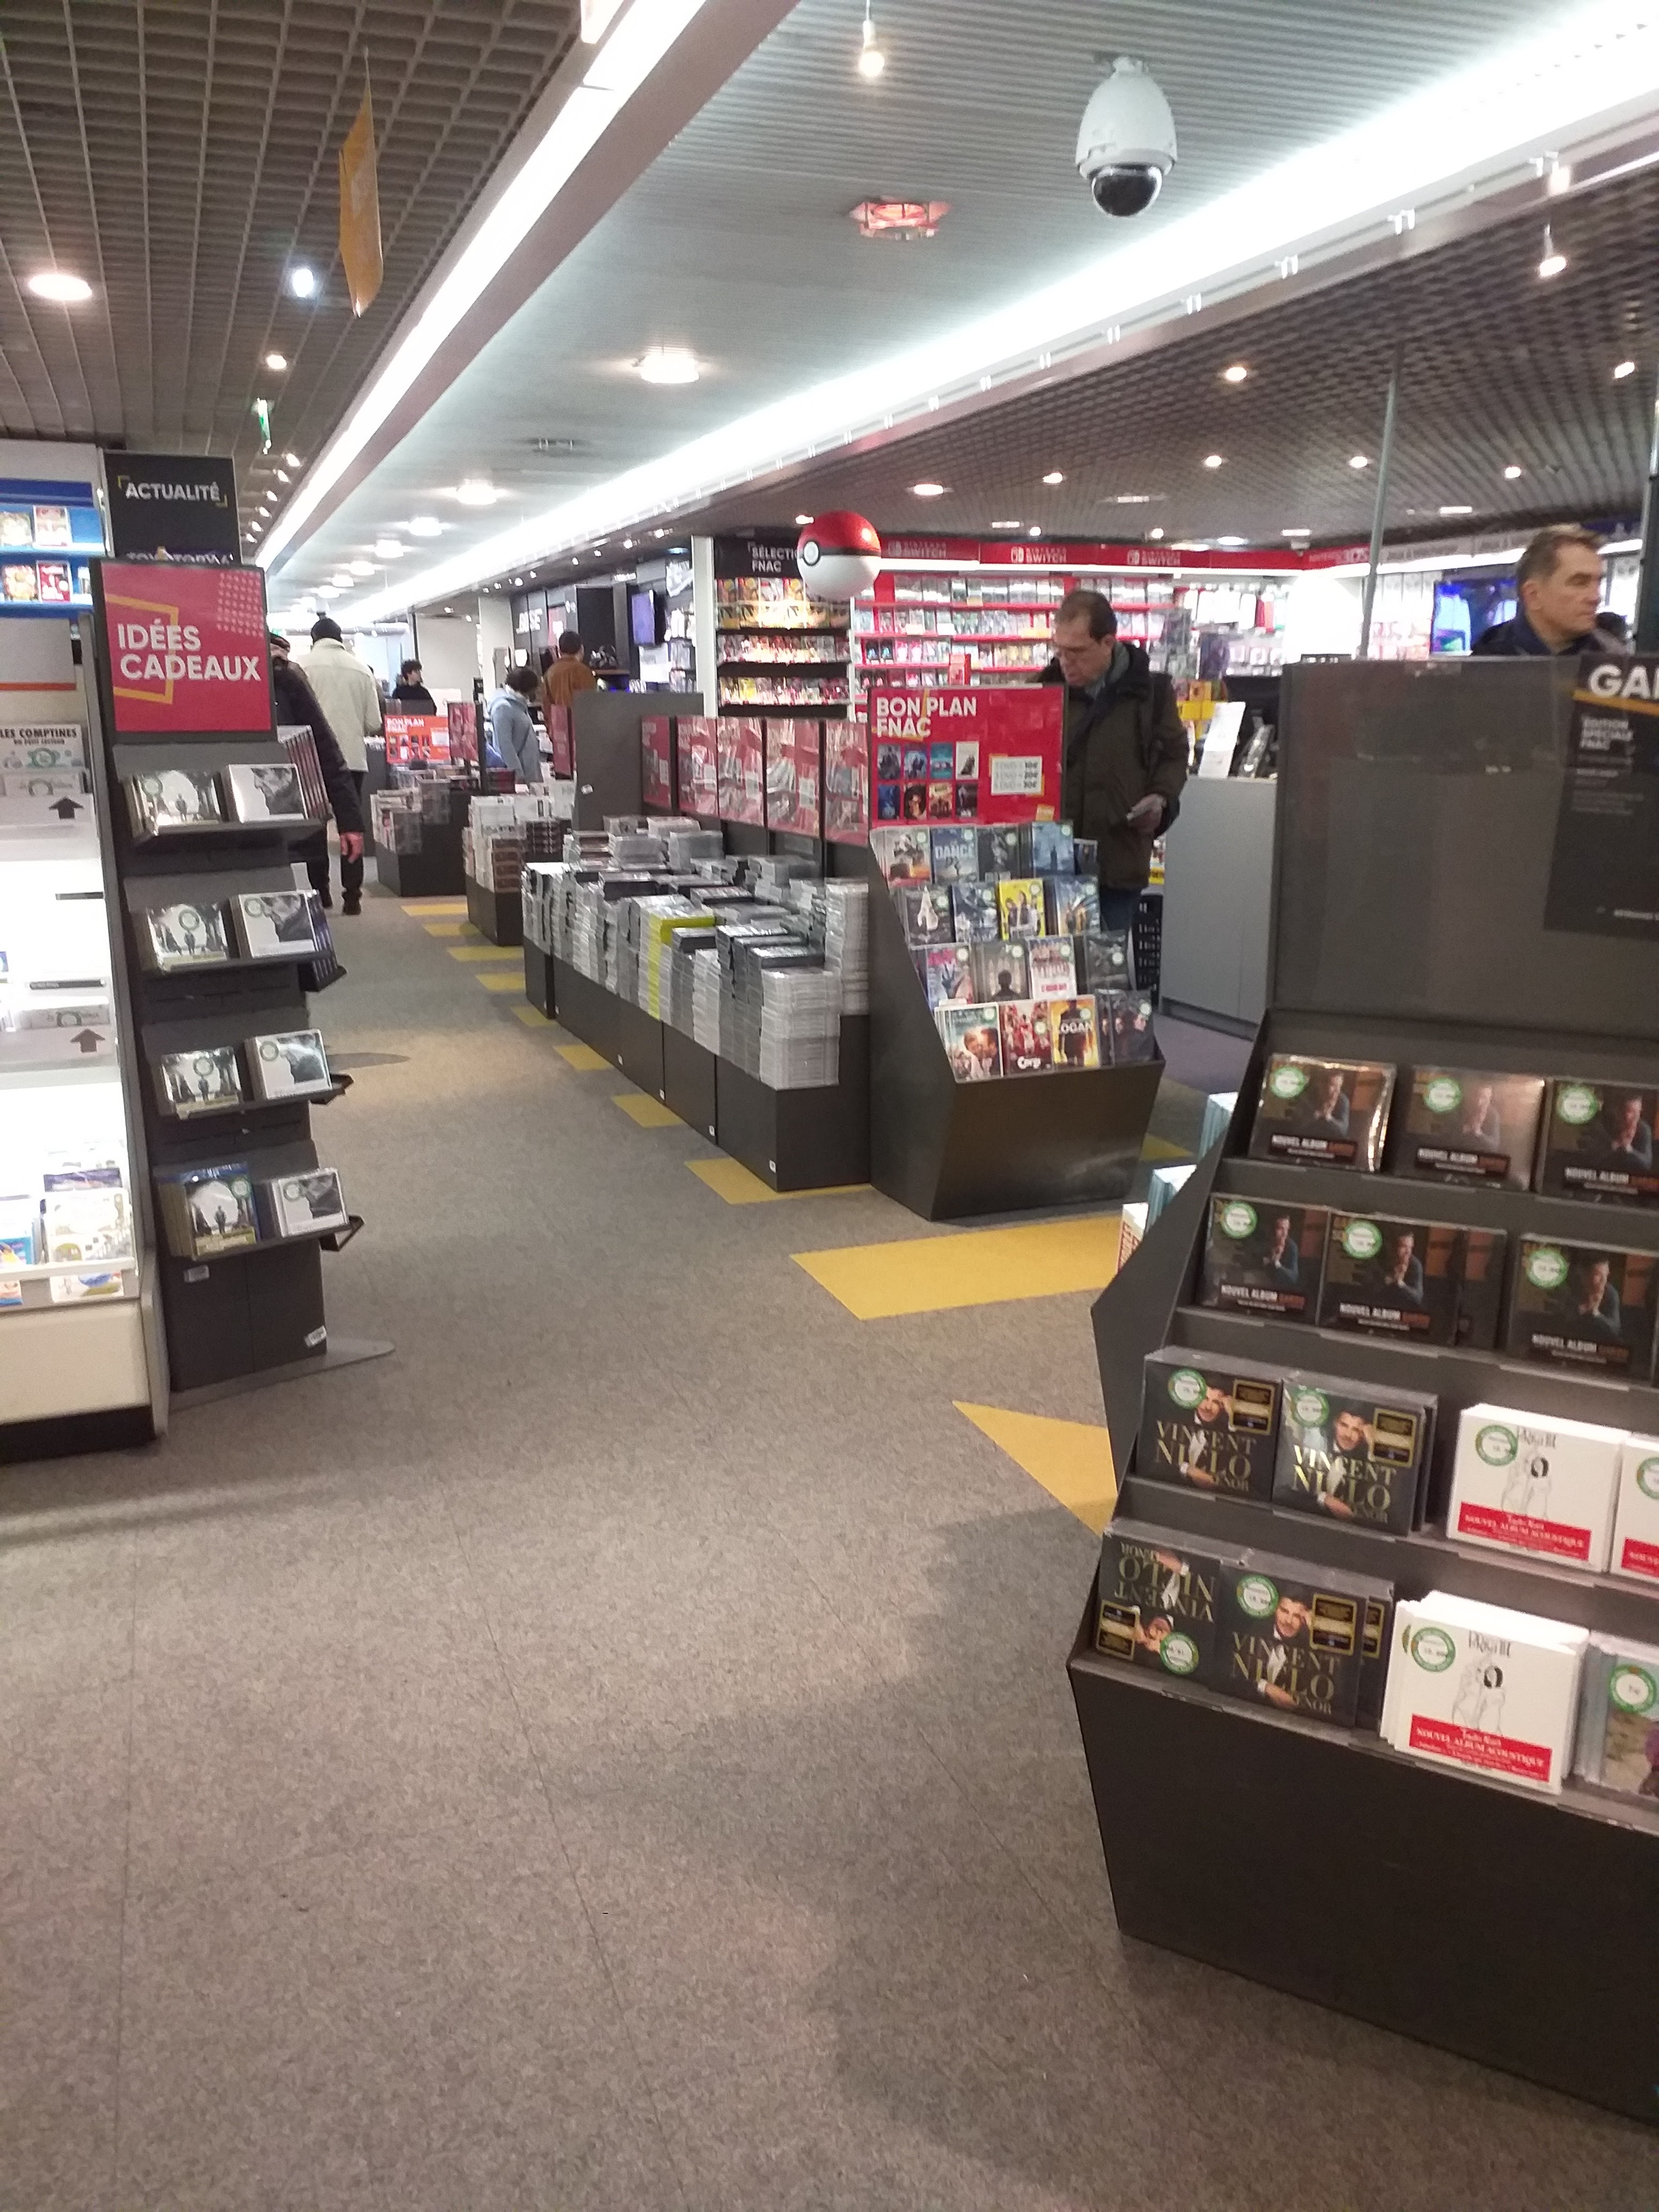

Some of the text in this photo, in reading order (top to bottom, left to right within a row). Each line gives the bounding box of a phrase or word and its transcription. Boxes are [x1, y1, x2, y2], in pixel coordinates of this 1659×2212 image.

[125, 481, 220, 501] ACTUALITÉ
[752, 559, 782, 572] FNAC
[117, 618, 201, 651] IDÉES
[120, 653, 261, 682] CADEAUX
[877, 696, 976, 718] BON PLAN
[19, 728, 77, 738] COMPTINES
[877, 717, 931, 738] FNAC
[1059, 1020, 1093, 1034] OGAN
[1155, 1438, 1251, 1480] NILO
[1291, 1464, 1391, 1511] NILO
[1118, 1555, 1215, 1602] NILO
[1231, 1652, 1334, 1701] NILO
